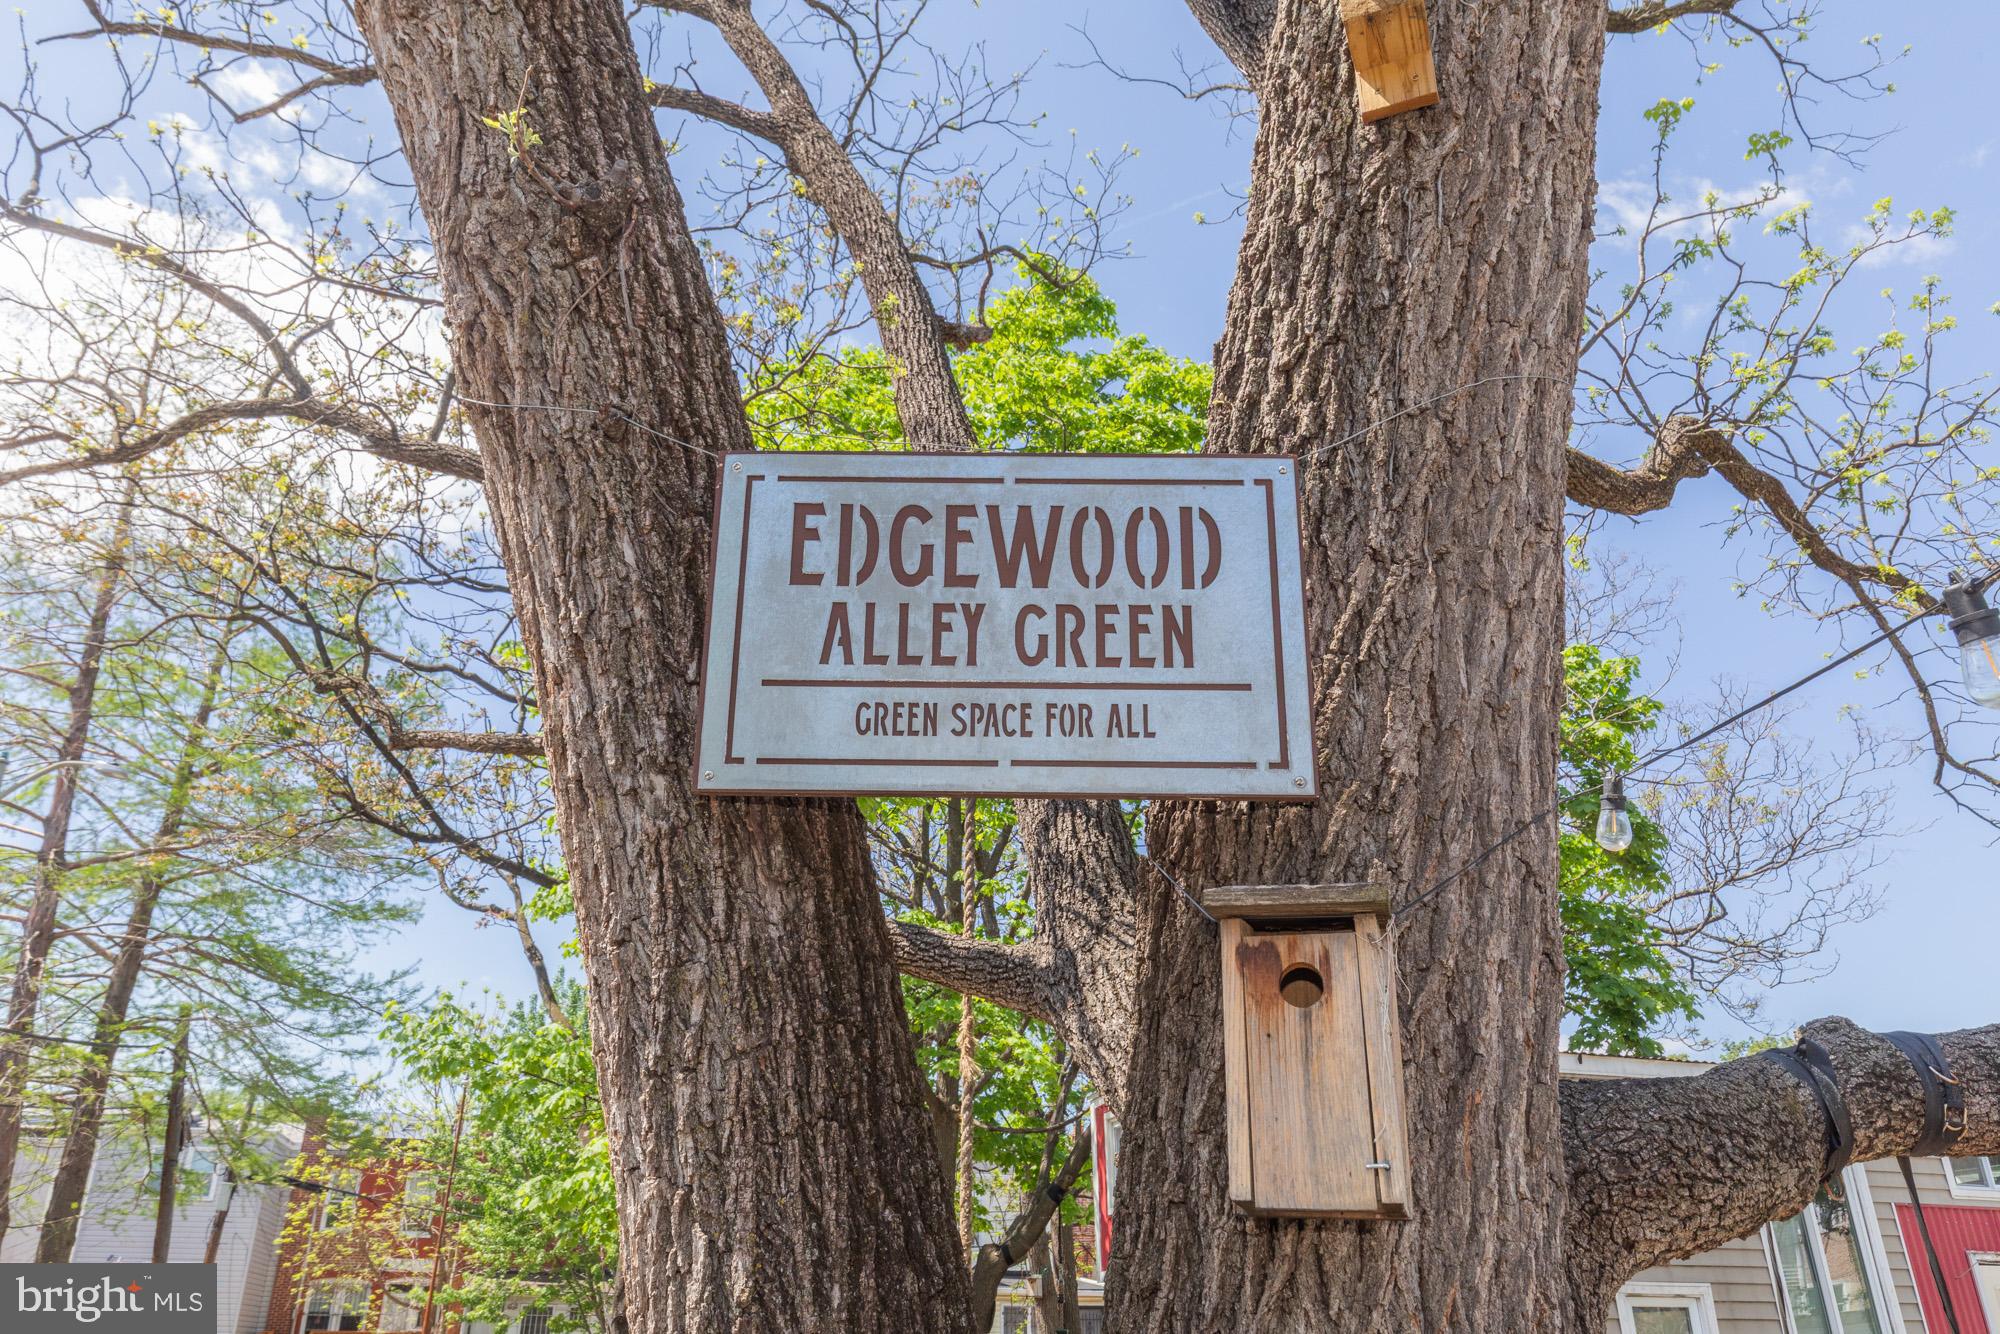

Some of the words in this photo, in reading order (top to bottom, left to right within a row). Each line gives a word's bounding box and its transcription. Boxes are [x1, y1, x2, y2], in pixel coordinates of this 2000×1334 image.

[788, 502, 1222, 590] EDGEWOOD
[819, 601, 986, 667] ALLEY
[1014, 603, 1195, 669] GREEN
[855, 701, 938, 738] GREEN
[951, 702, 1034, 739] SPACE
[1046, 703, 1095, 739] FOR
[1107, 703, 1157, 740] ALL
